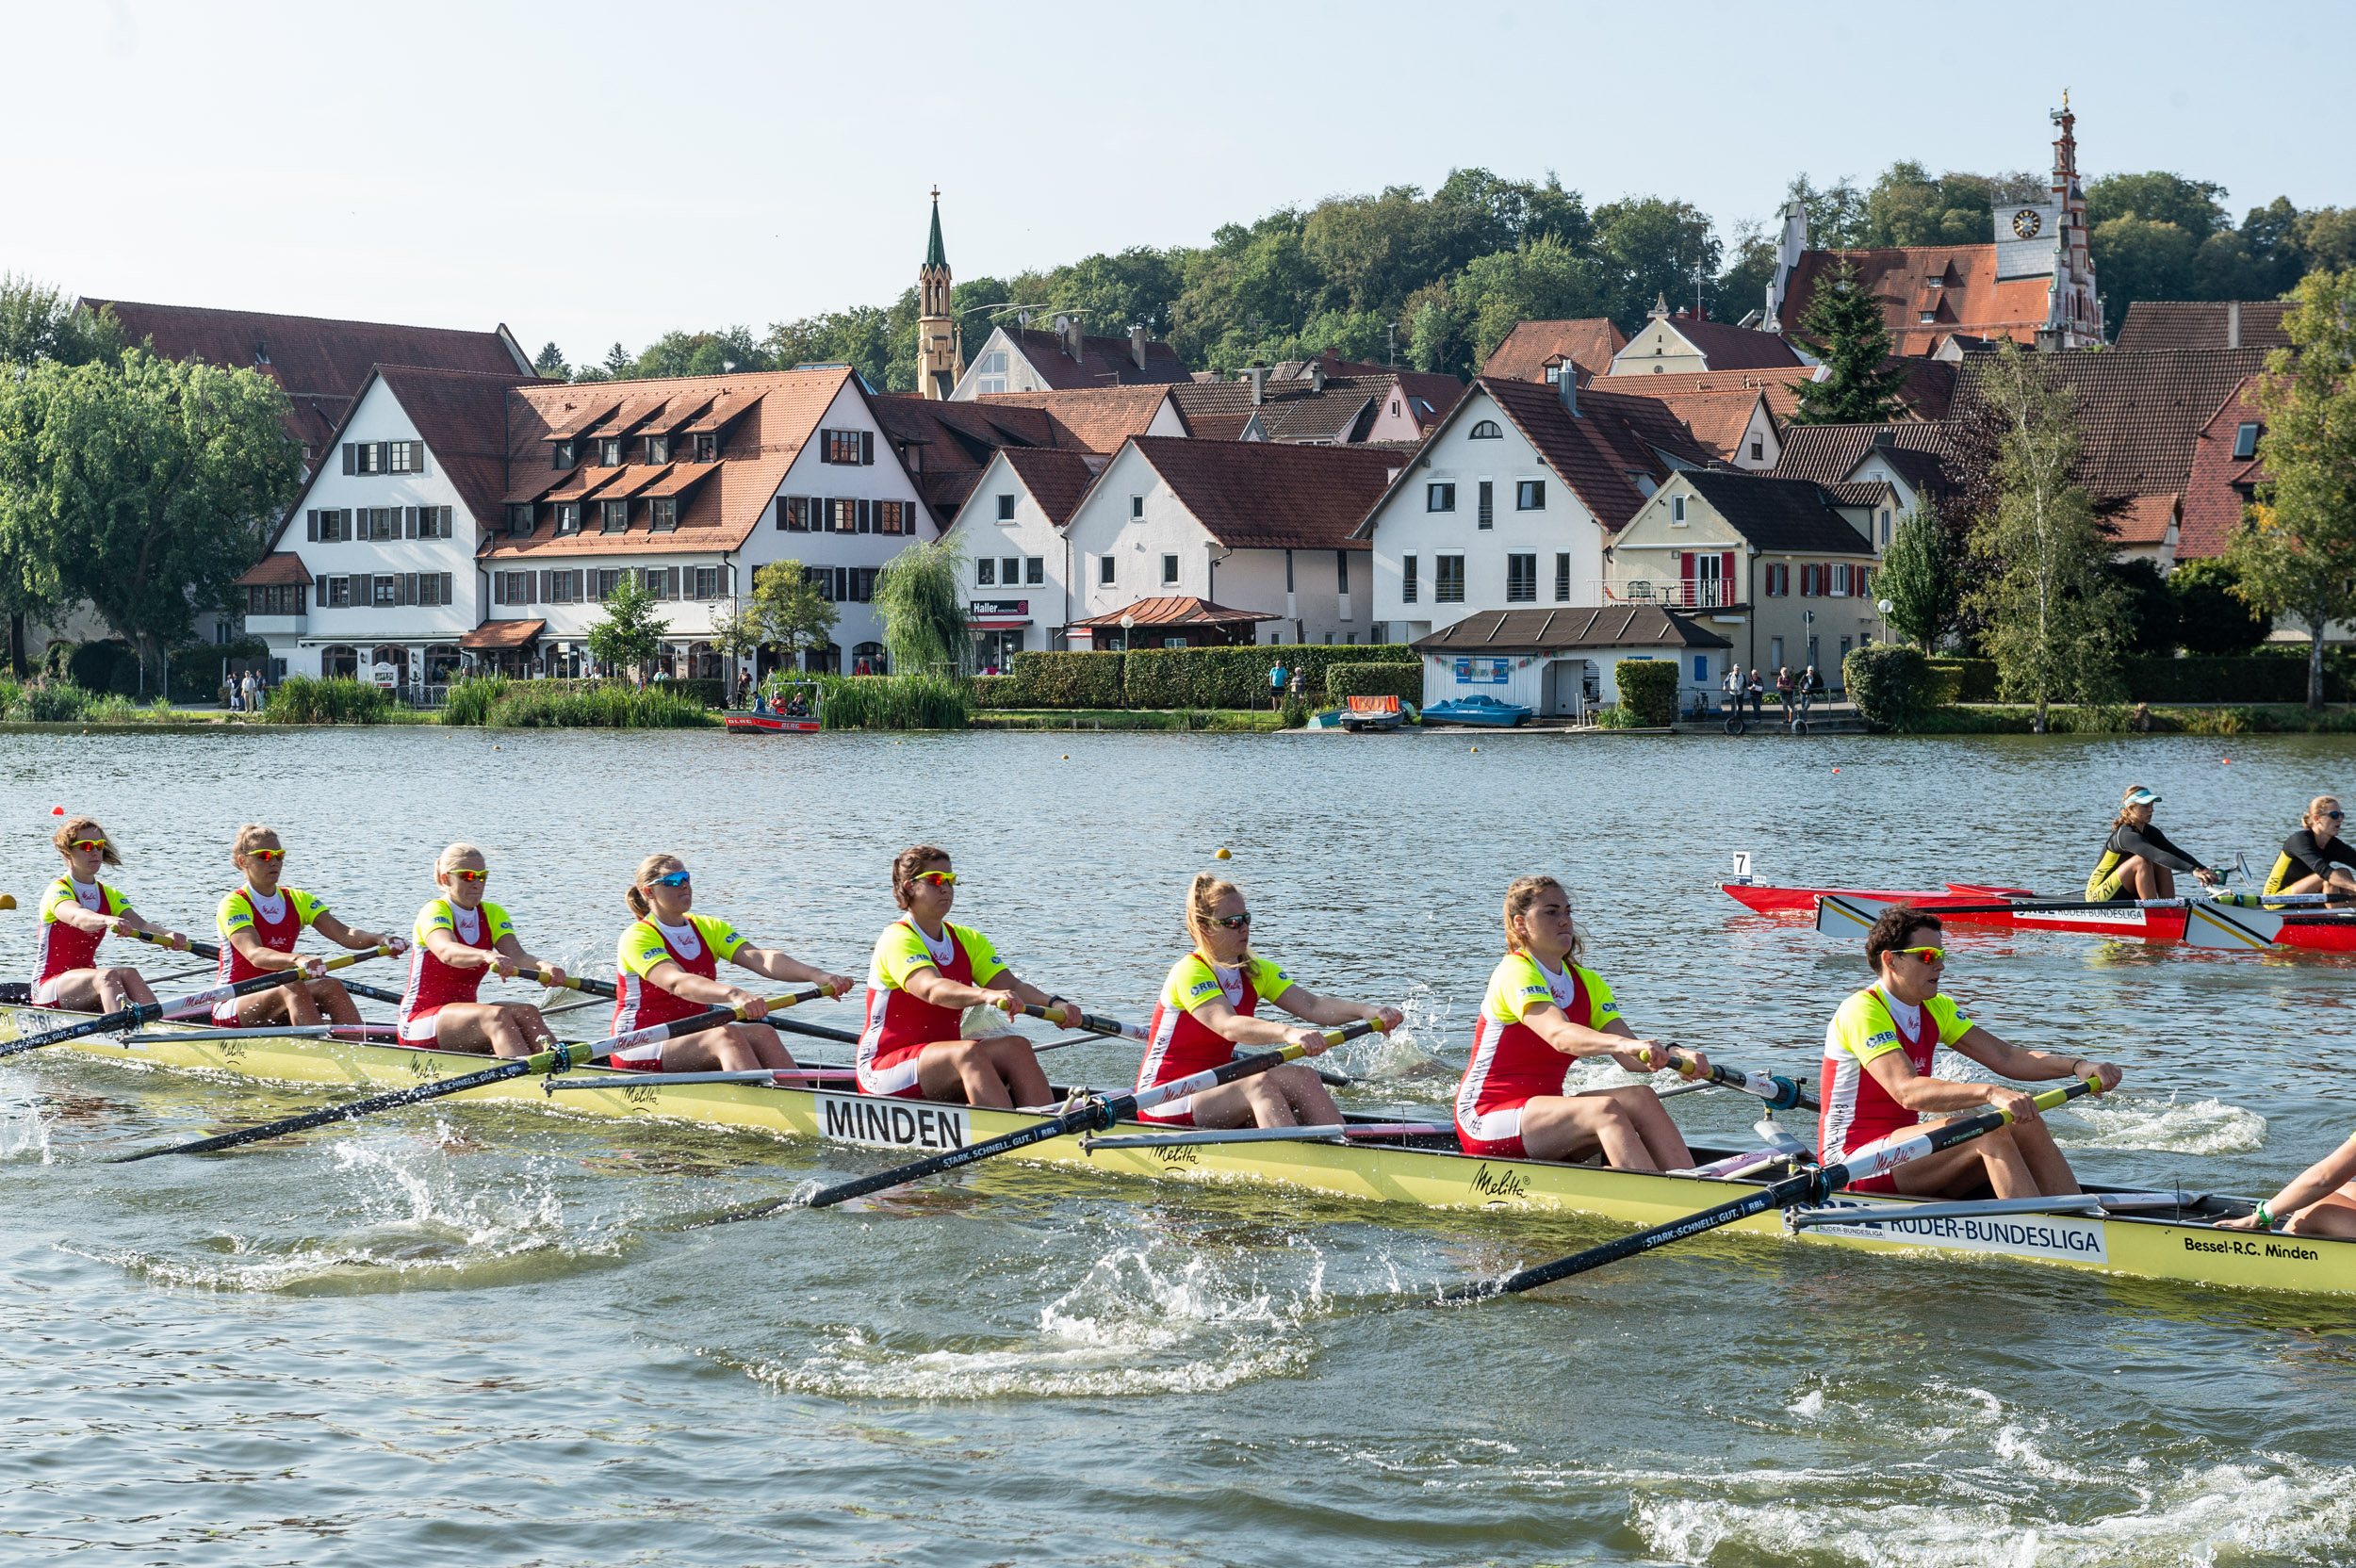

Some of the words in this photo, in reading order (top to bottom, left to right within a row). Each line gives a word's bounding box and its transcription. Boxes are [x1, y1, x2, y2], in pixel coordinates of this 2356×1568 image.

[973, 602, 998, 613] Haller
[1736, 854, 1746, 874] 7
[2102, 880, 2114, 898] RV
[1200, 981, 1218, 990] RBL
[1527, 986, 1549, 994] RBL
[216, 1040, 247, 1059] Melitta
[614, 1031, 651, 1050] Melitta
[620, 1086, 659, 1105] Melitta
[826, 1100, 963, 1149] MINDEN
[942, 1152, 973, 1168] STARK.
[973, 1143, 1012, 1158] SCHNELL.
[1012, 1135, 1032, 1147] GUT.
[1041, 1126, 1057, 1135] RBL
[1148, 1145, 1200, 1165] Melitta
[1871, 1147, 1910, 1175] Melitta
[1468, 1162, 1528, 1199] Melitta
[1646, 1230, 1677, 1248] STARK.
[1677, 1217, 1719, 1236] SCHNELL.
[1719, 1208, 1740, 1222] GUT.
[1748, 1200, 1765, 1211] RBL
[1819, 1225, 1884, 1237] RUDER-BUNDESLIGA
[1890, 1217, 2101, 1253] RUDER-BUNDESLIGA
[2184, 1237, 2261, 1256] Bessel-R.C.
[2265, 1244, 2318, 1261] Minden
